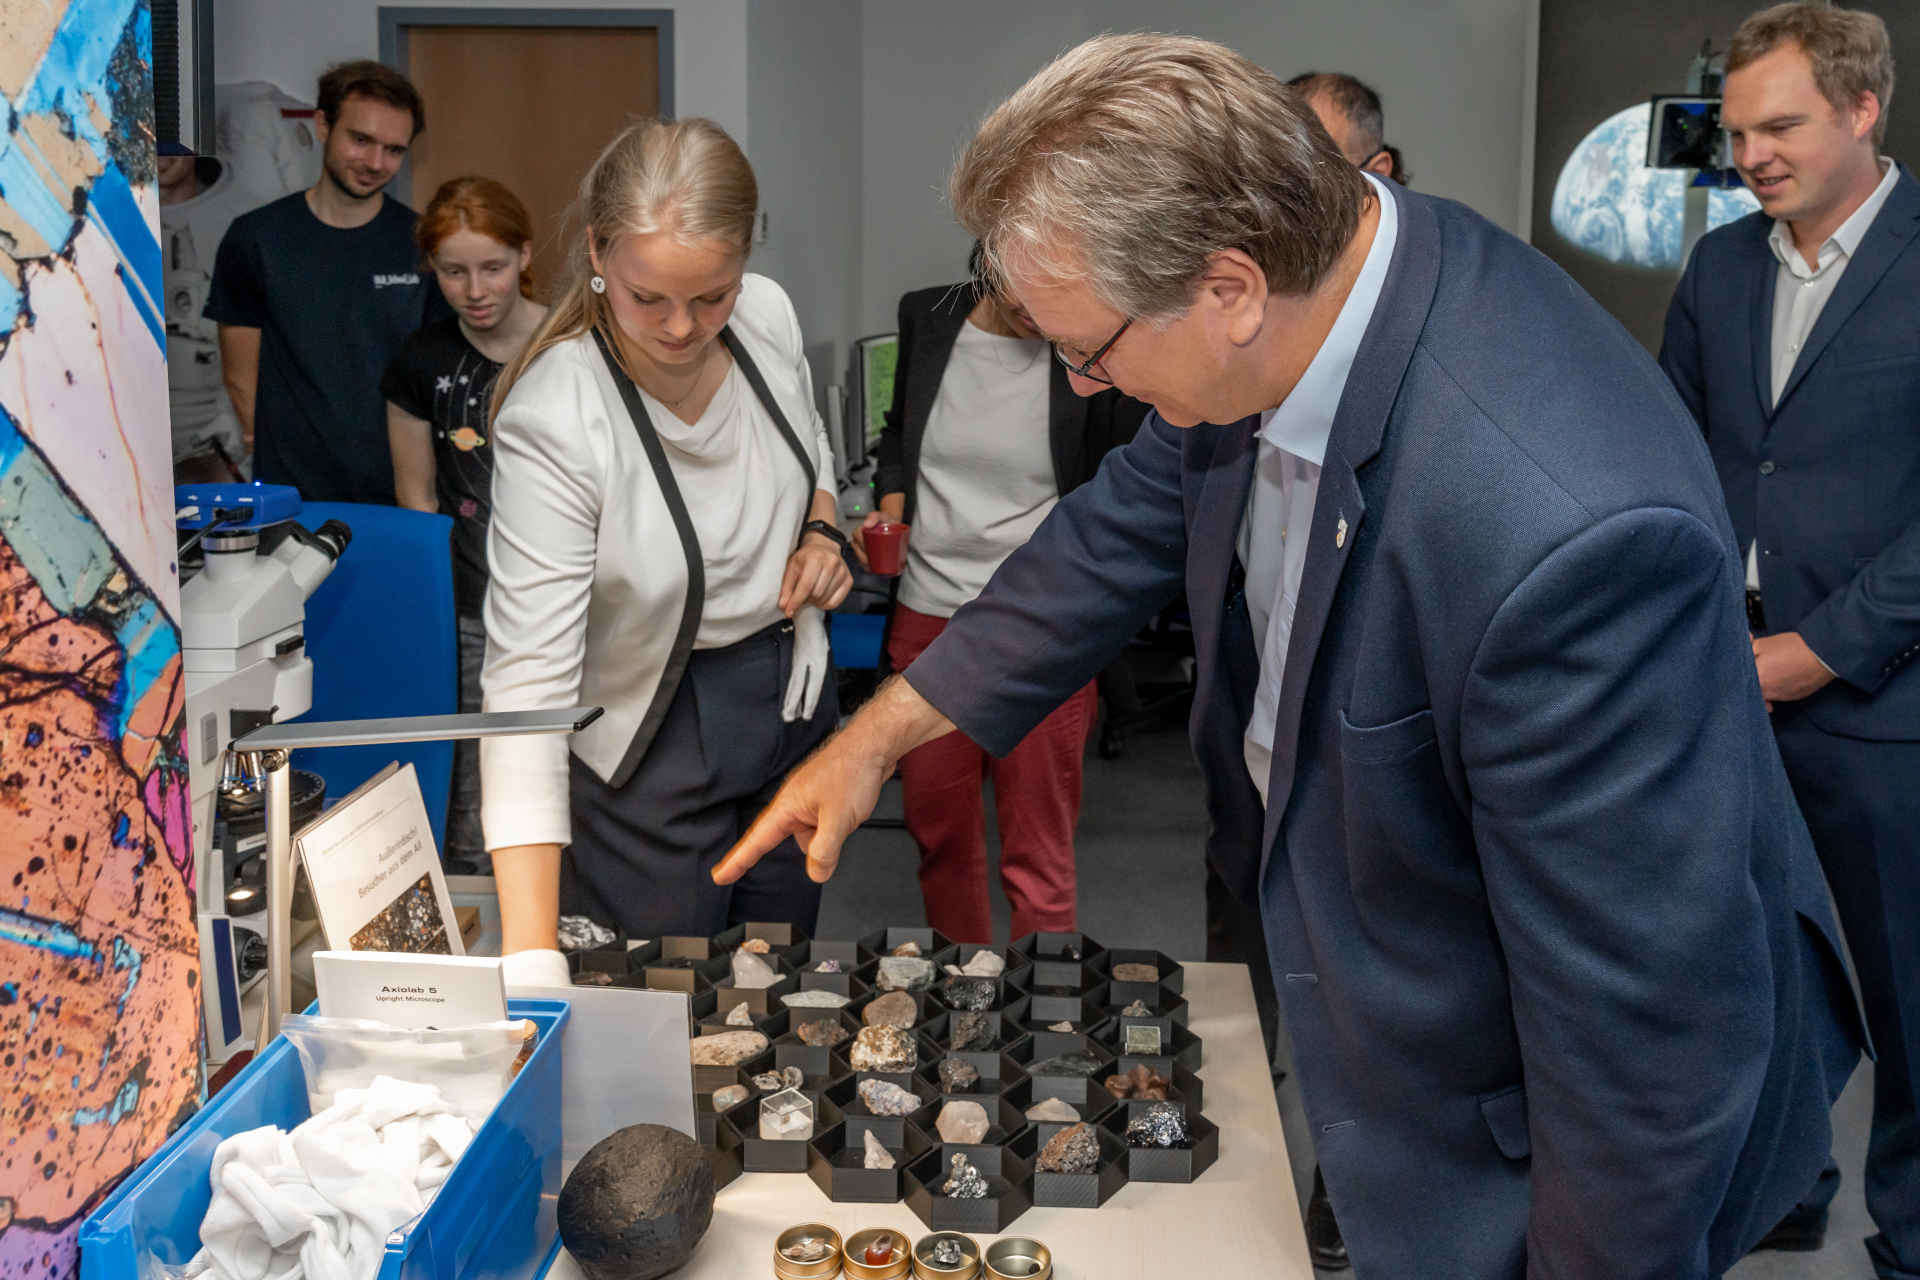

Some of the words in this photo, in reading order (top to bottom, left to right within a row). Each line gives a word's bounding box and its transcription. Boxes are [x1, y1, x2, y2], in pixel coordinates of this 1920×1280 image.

[381, 985, 425, 994] Axiolab
[428, 986, 438, 994] 5
[375, 994, 403, 1003] Upright
[405, 995, 446, 1004] Microscope
